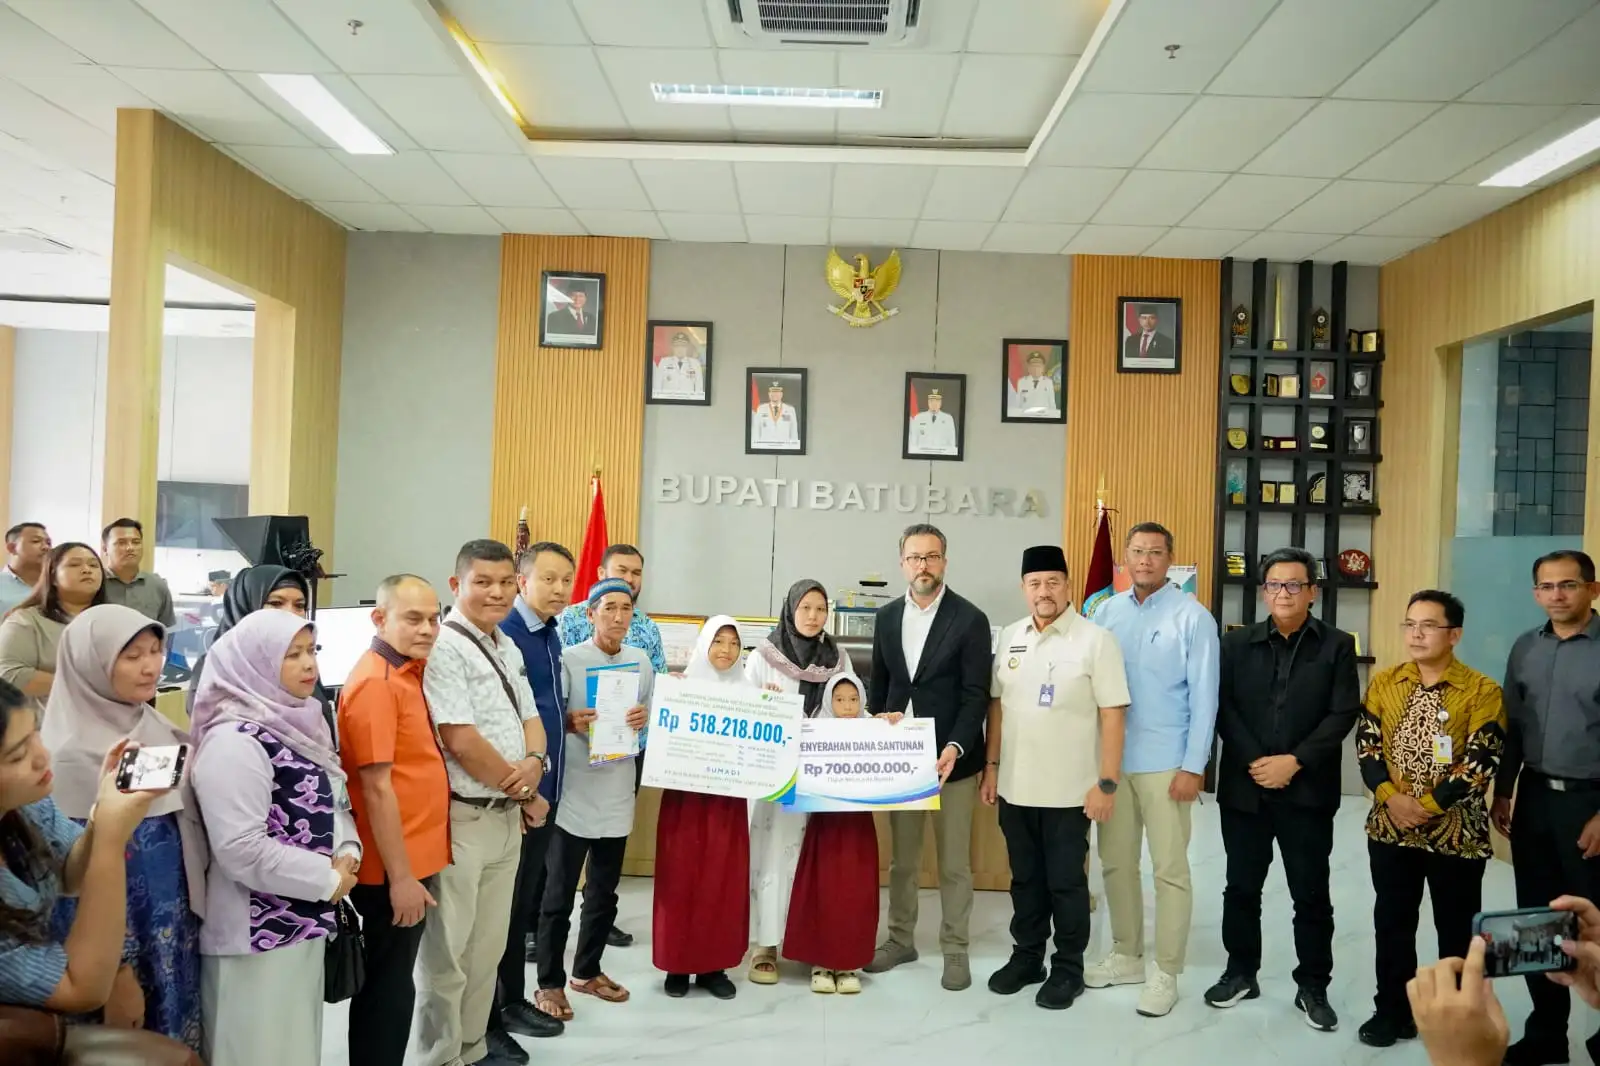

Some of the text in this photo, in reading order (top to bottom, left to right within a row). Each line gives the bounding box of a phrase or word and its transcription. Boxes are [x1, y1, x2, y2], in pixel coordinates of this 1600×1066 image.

[659, 475, 799, 508] BUPATI
[658, 708, 679, 732] Rp
[689, 712, 793, 747] 518.218.000,-
[800, 740, 924, 752] ENYERAHAN DANA SANTUNAN
[706, 766, 741, 777] SUMADI
[804, 762, 918, 777] Rp 700.000.000,-
